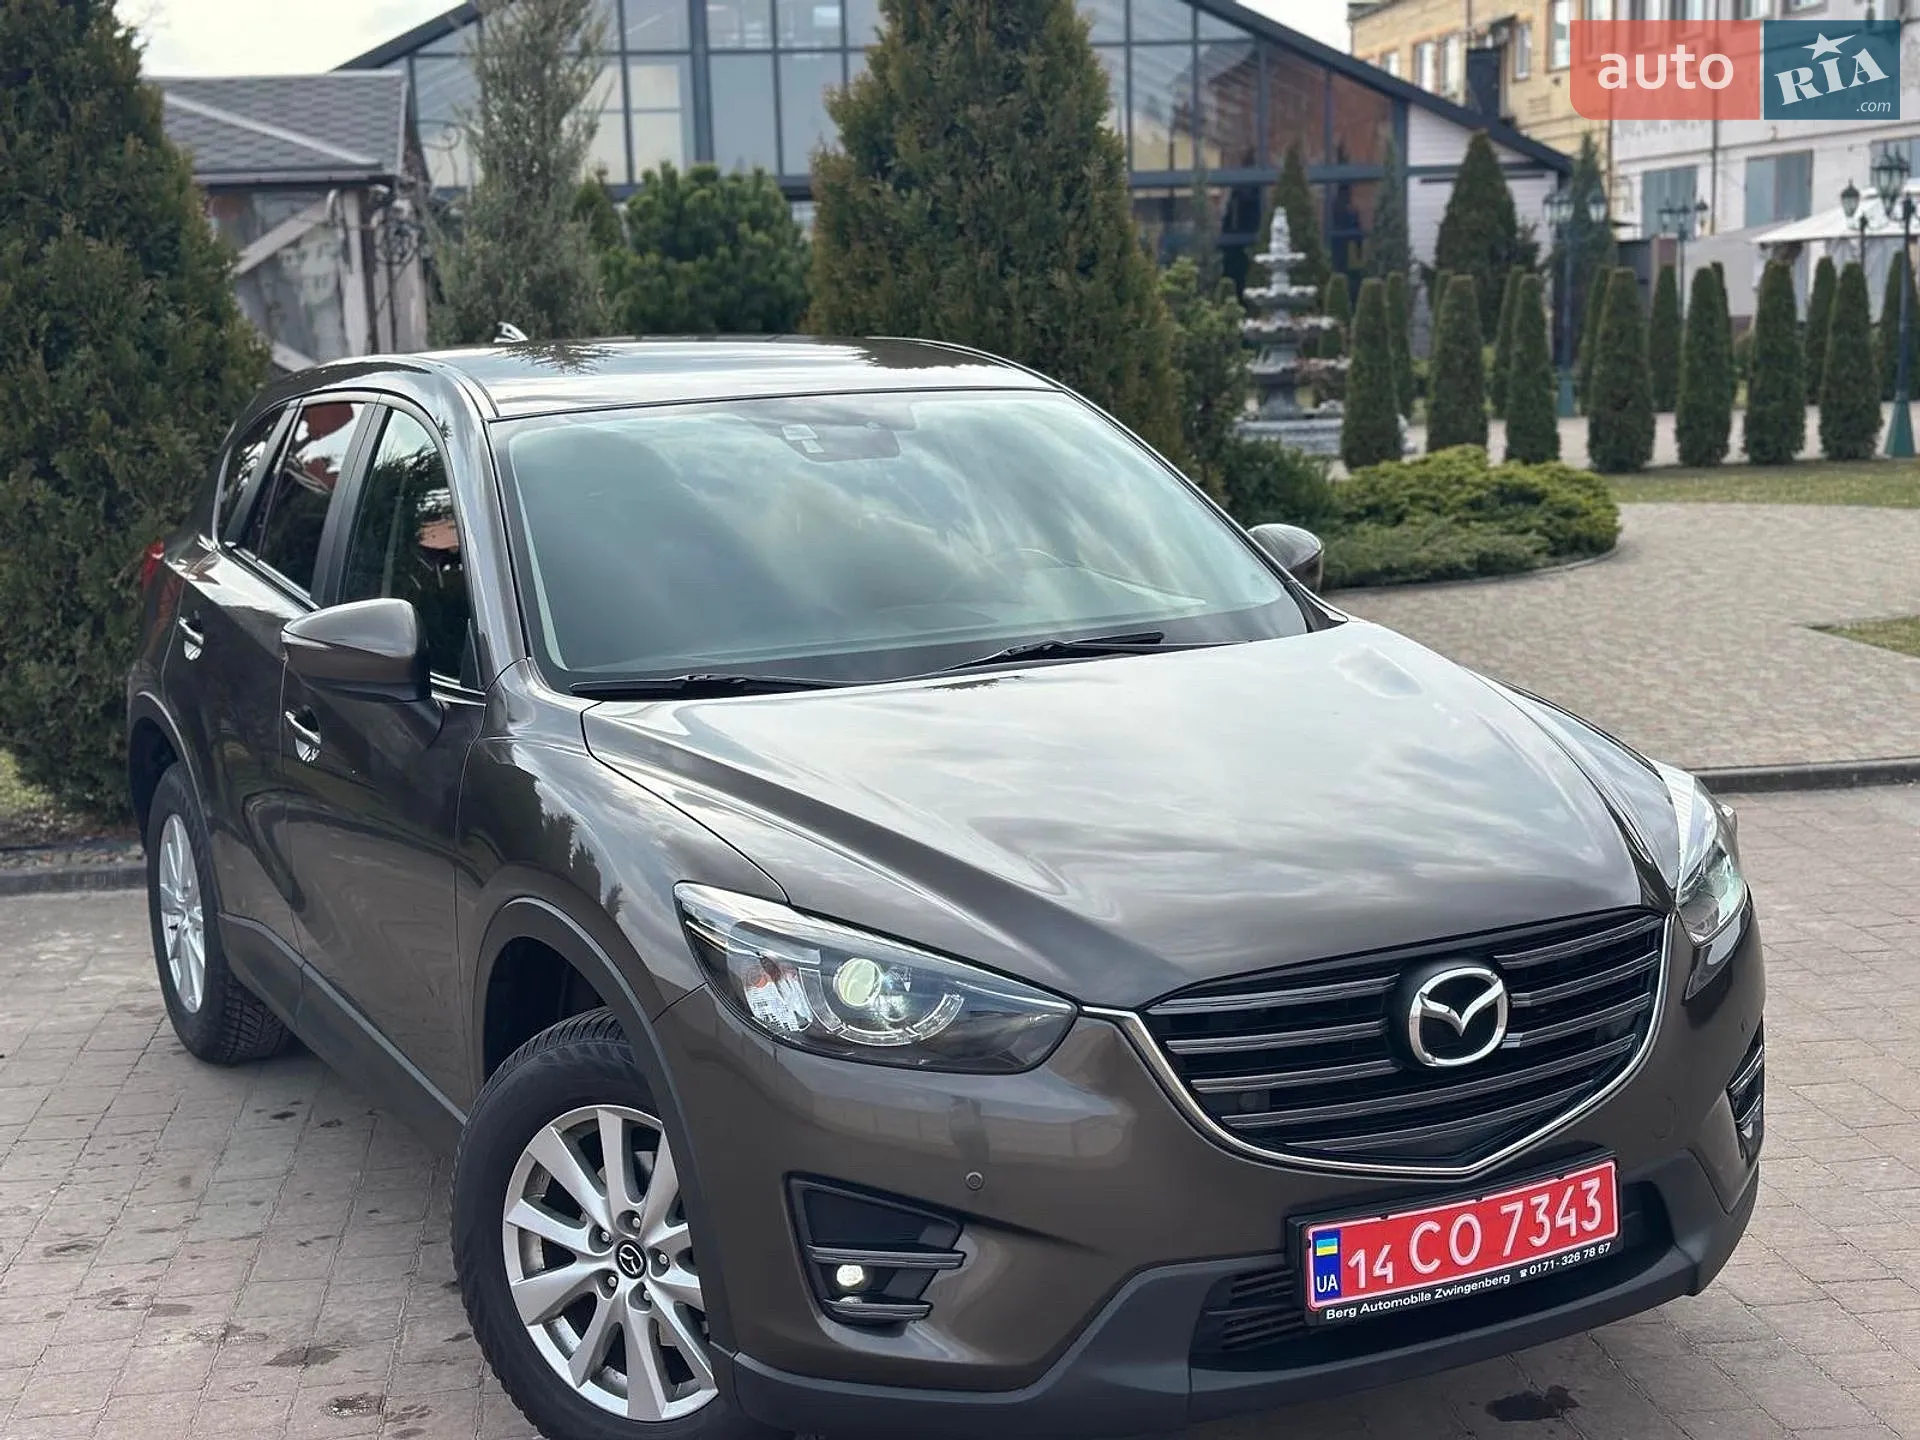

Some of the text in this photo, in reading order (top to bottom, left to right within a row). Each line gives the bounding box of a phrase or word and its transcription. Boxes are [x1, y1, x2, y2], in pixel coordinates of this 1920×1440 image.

[1347, 1177, 1602, 1289] 14 CO 7343
[1316, 1274, 1339, 1293] UA
[1326, 1305, 1357, 1320] Berg
[1360, 1291, 1432, 1314] Automobile
[1434, 1273, 1511, 1299] Zwingenberg
[1582, 1246, 1596, 1259] 78
[1598, 1242, 1611, 1255] 67
